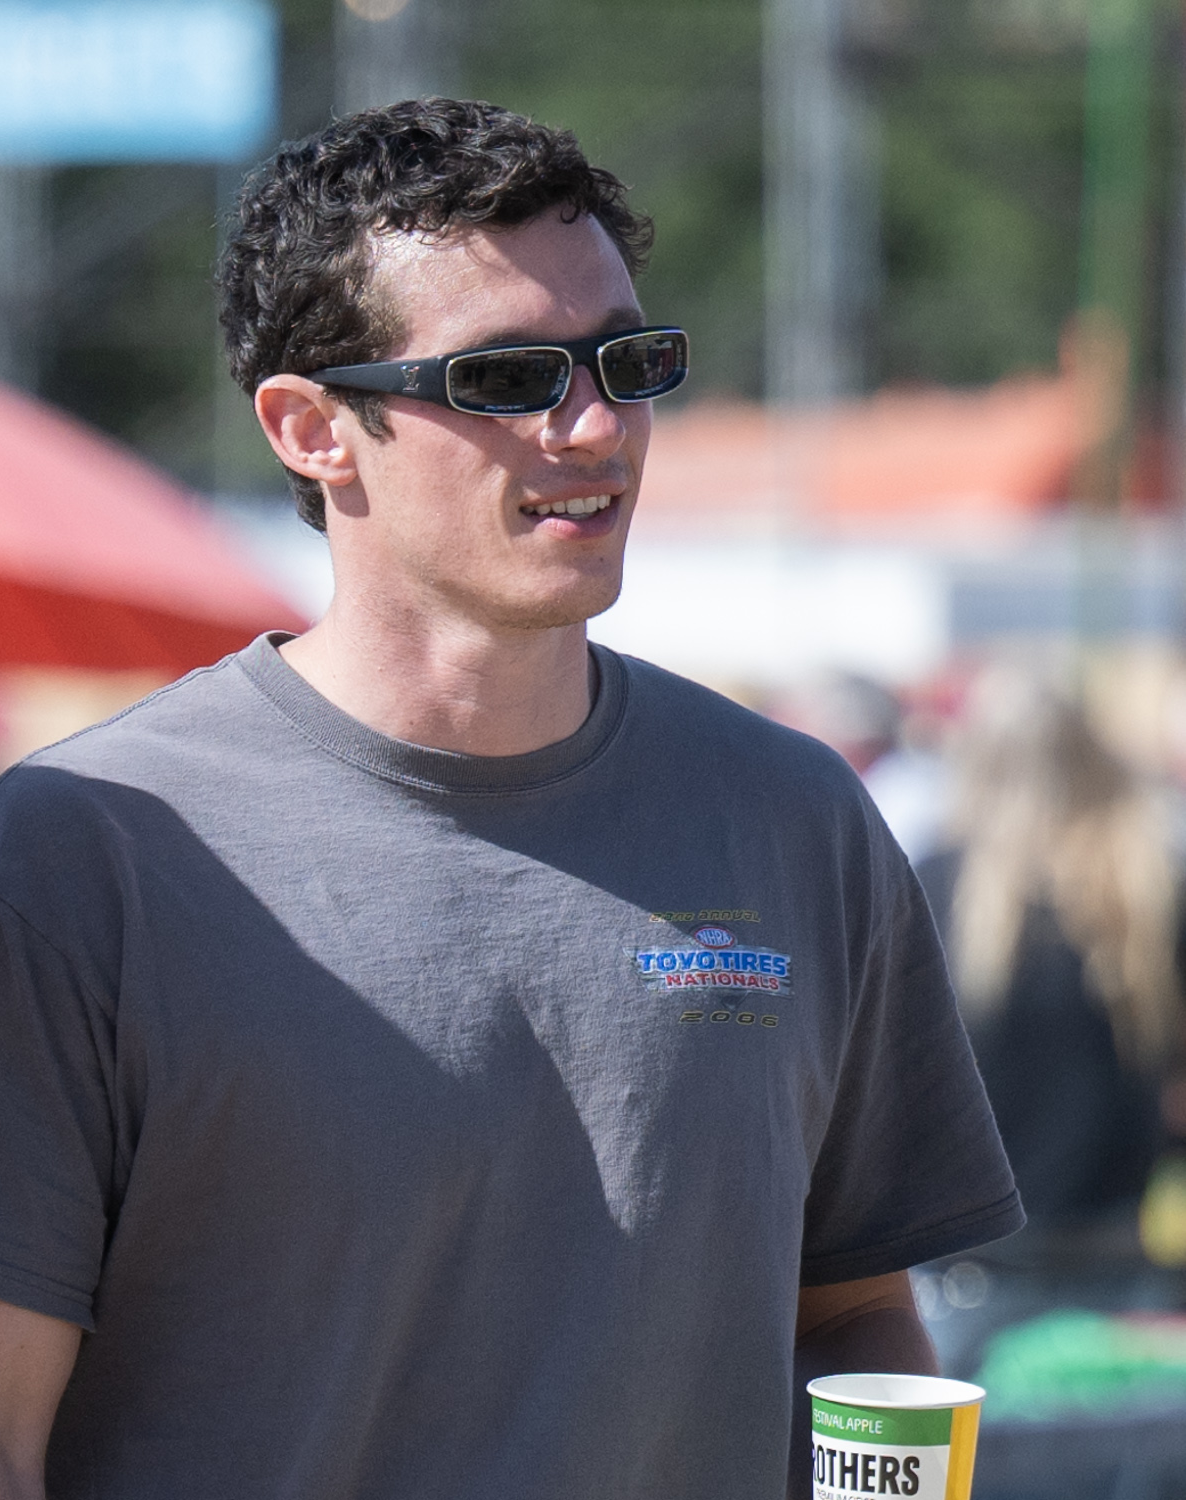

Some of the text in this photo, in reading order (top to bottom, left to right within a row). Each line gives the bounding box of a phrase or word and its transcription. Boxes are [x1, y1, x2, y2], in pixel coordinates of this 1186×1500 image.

[696, 927, 733, 947] NHRA
[637, 951, 788, 977] TOYO TIRES
[665, 973, 780, 991] NATIONALS
[679, 1010, 780, 1028] 2006
[845, 1417, 884, 1435] APPLE
